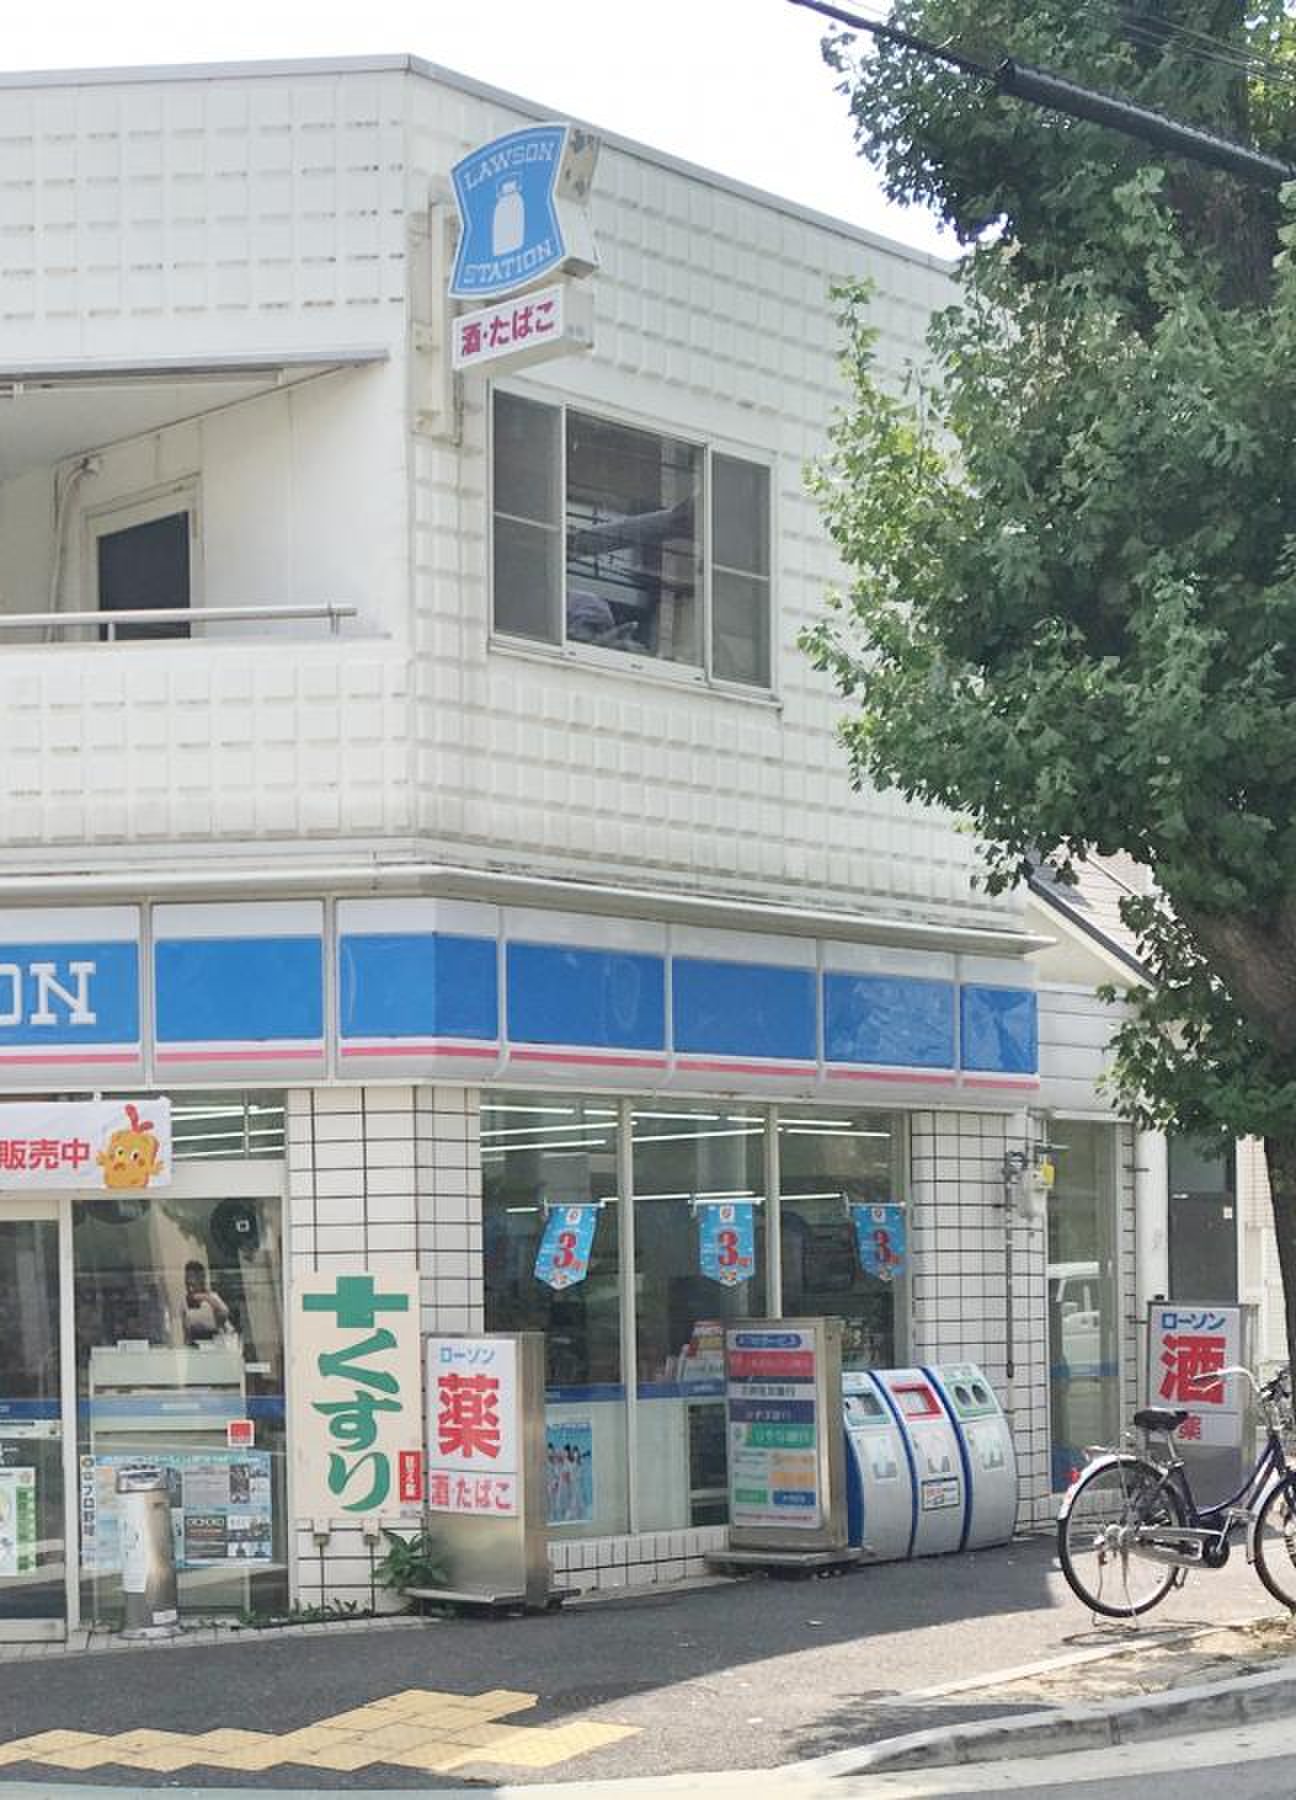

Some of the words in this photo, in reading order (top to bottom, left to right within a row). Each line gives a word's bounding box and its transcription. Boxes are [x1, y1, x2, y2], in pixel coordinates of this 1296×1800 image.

[463, 141, 557, 191] LAWSON
[462, 239, 555, 284] STATION
[1161, 1312, 1227, 1331] ローソン
[439, 1346, 495, 1364] ローソン
[1159, 1333, 1227, 1404] 酒
[311, 1327, 404, 1513] くすり
[437, 1373, 501, 1459] 薬
